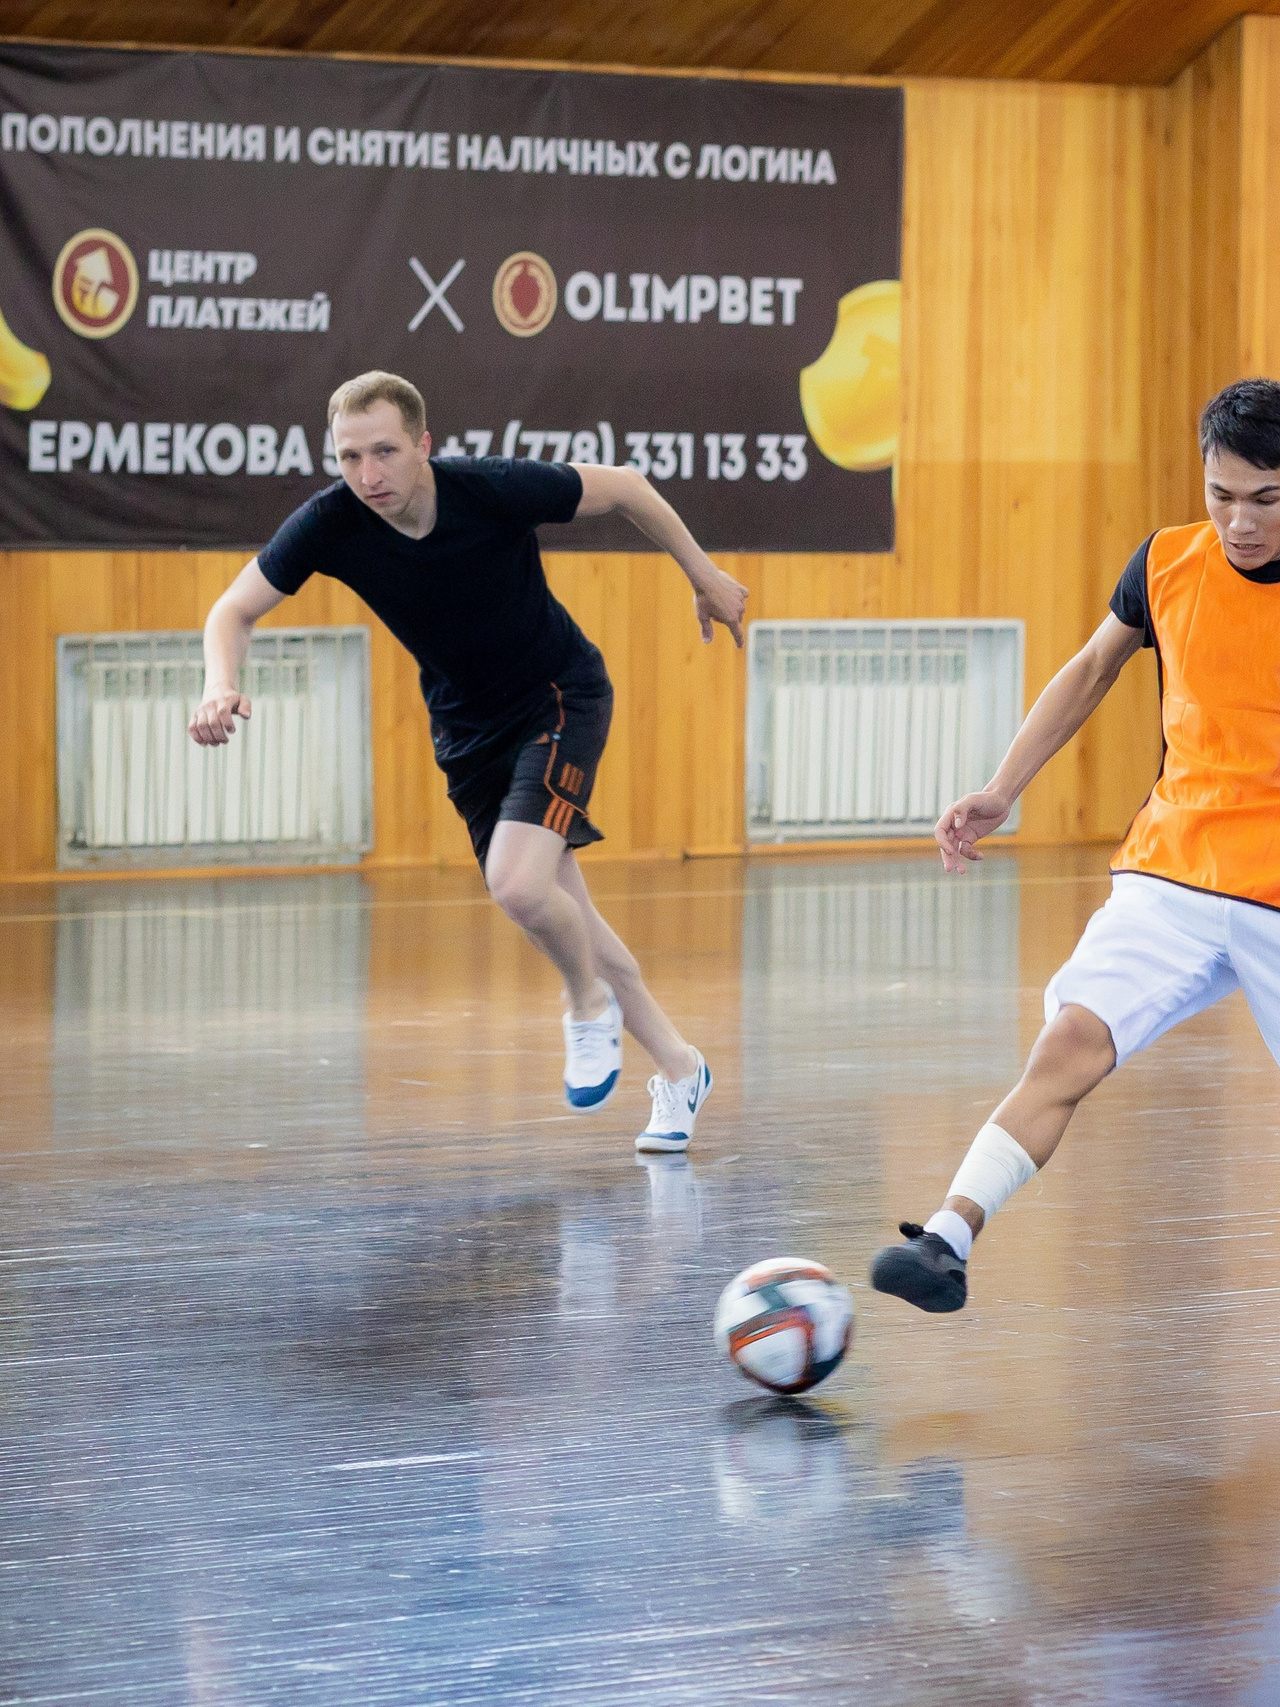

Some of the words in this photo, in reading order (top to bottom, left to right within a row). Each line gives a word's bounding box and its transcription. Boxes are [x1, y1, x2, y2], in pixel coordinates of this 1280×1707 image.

[2, 112, 267, 162] ПОПОЛНЕНИЯ
[274, 126, 301, 164] И
[307, 127, 451, 170] СНЯТИЕ
[457, 134, 660, 178] НАЛИЧНЫХ
[664, 143, 692, 180] С
[696, 145, 838, 186] ЛОГИНА
[148, 249, 258, 287] ЦЕНТР
[147, 292, 332, 332] ПЛАТЕЖЕЙ
[564, 271, 804, 327] OLIMPBET
[28, 420, 315, 476] ЕРМЕКОВА
[624, 432, 695, 480] 331
[703, 433, 748, 481] 13
[756, 434, 809, 482] 33
